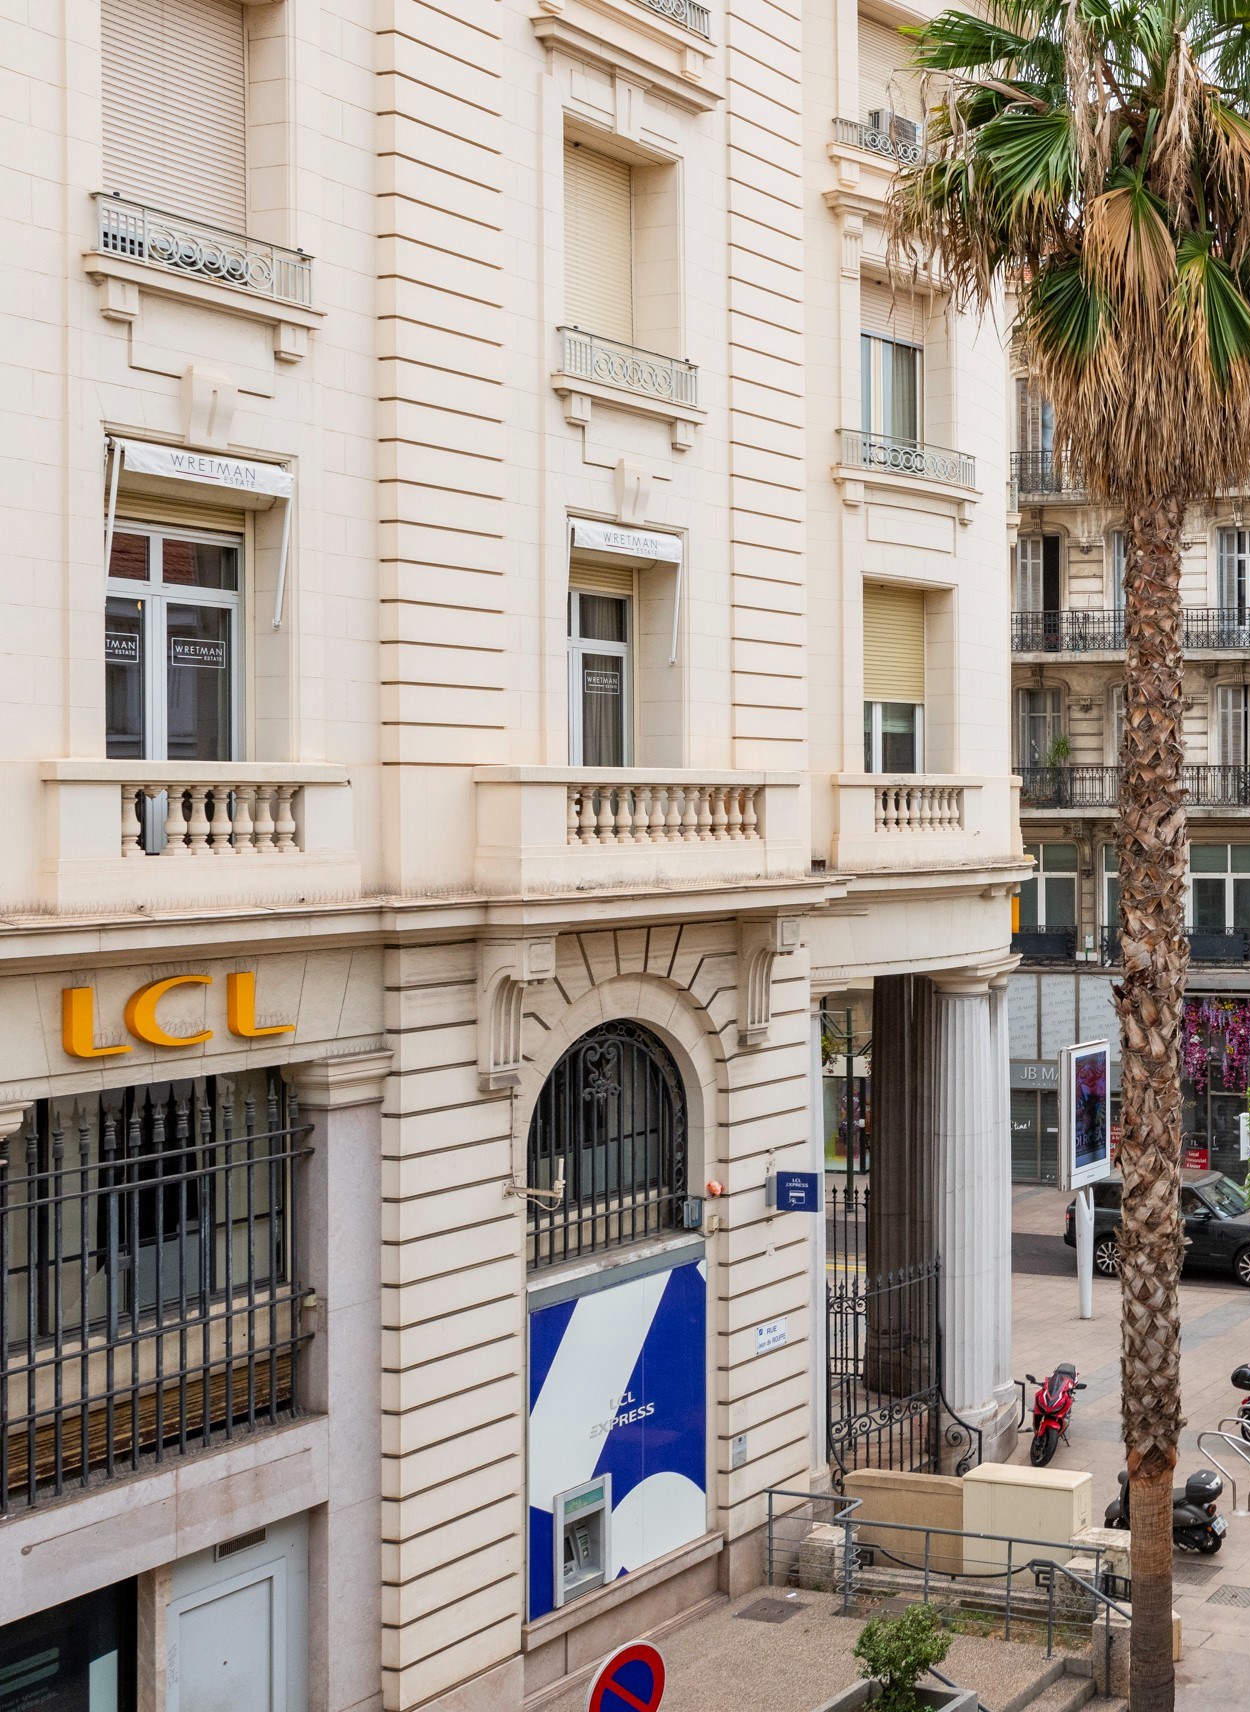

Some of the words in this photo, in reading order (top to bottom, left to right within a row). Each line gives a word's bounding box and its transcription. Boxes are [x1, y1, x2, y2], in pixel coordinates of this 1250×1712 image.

[170, 453, 257, 481] WRETMAN
[223, 477, 257, 489] ESTATE
[602, 531, 659, 550] WRETMAN
[636, 548, 658, 556] ESTATE
[174, 644, 223, 656] WRETMAN
[586, 675, 618, 685] WRETMAN
[62, 971, 297, 1059] LCL
[1020, 1066, 1038, 1081] JB
[766, 1324, 779, 1335] RUE
[609, 1391, 636, 1412] LCL
[589, 1402, 656, 1440] EXPRESS
